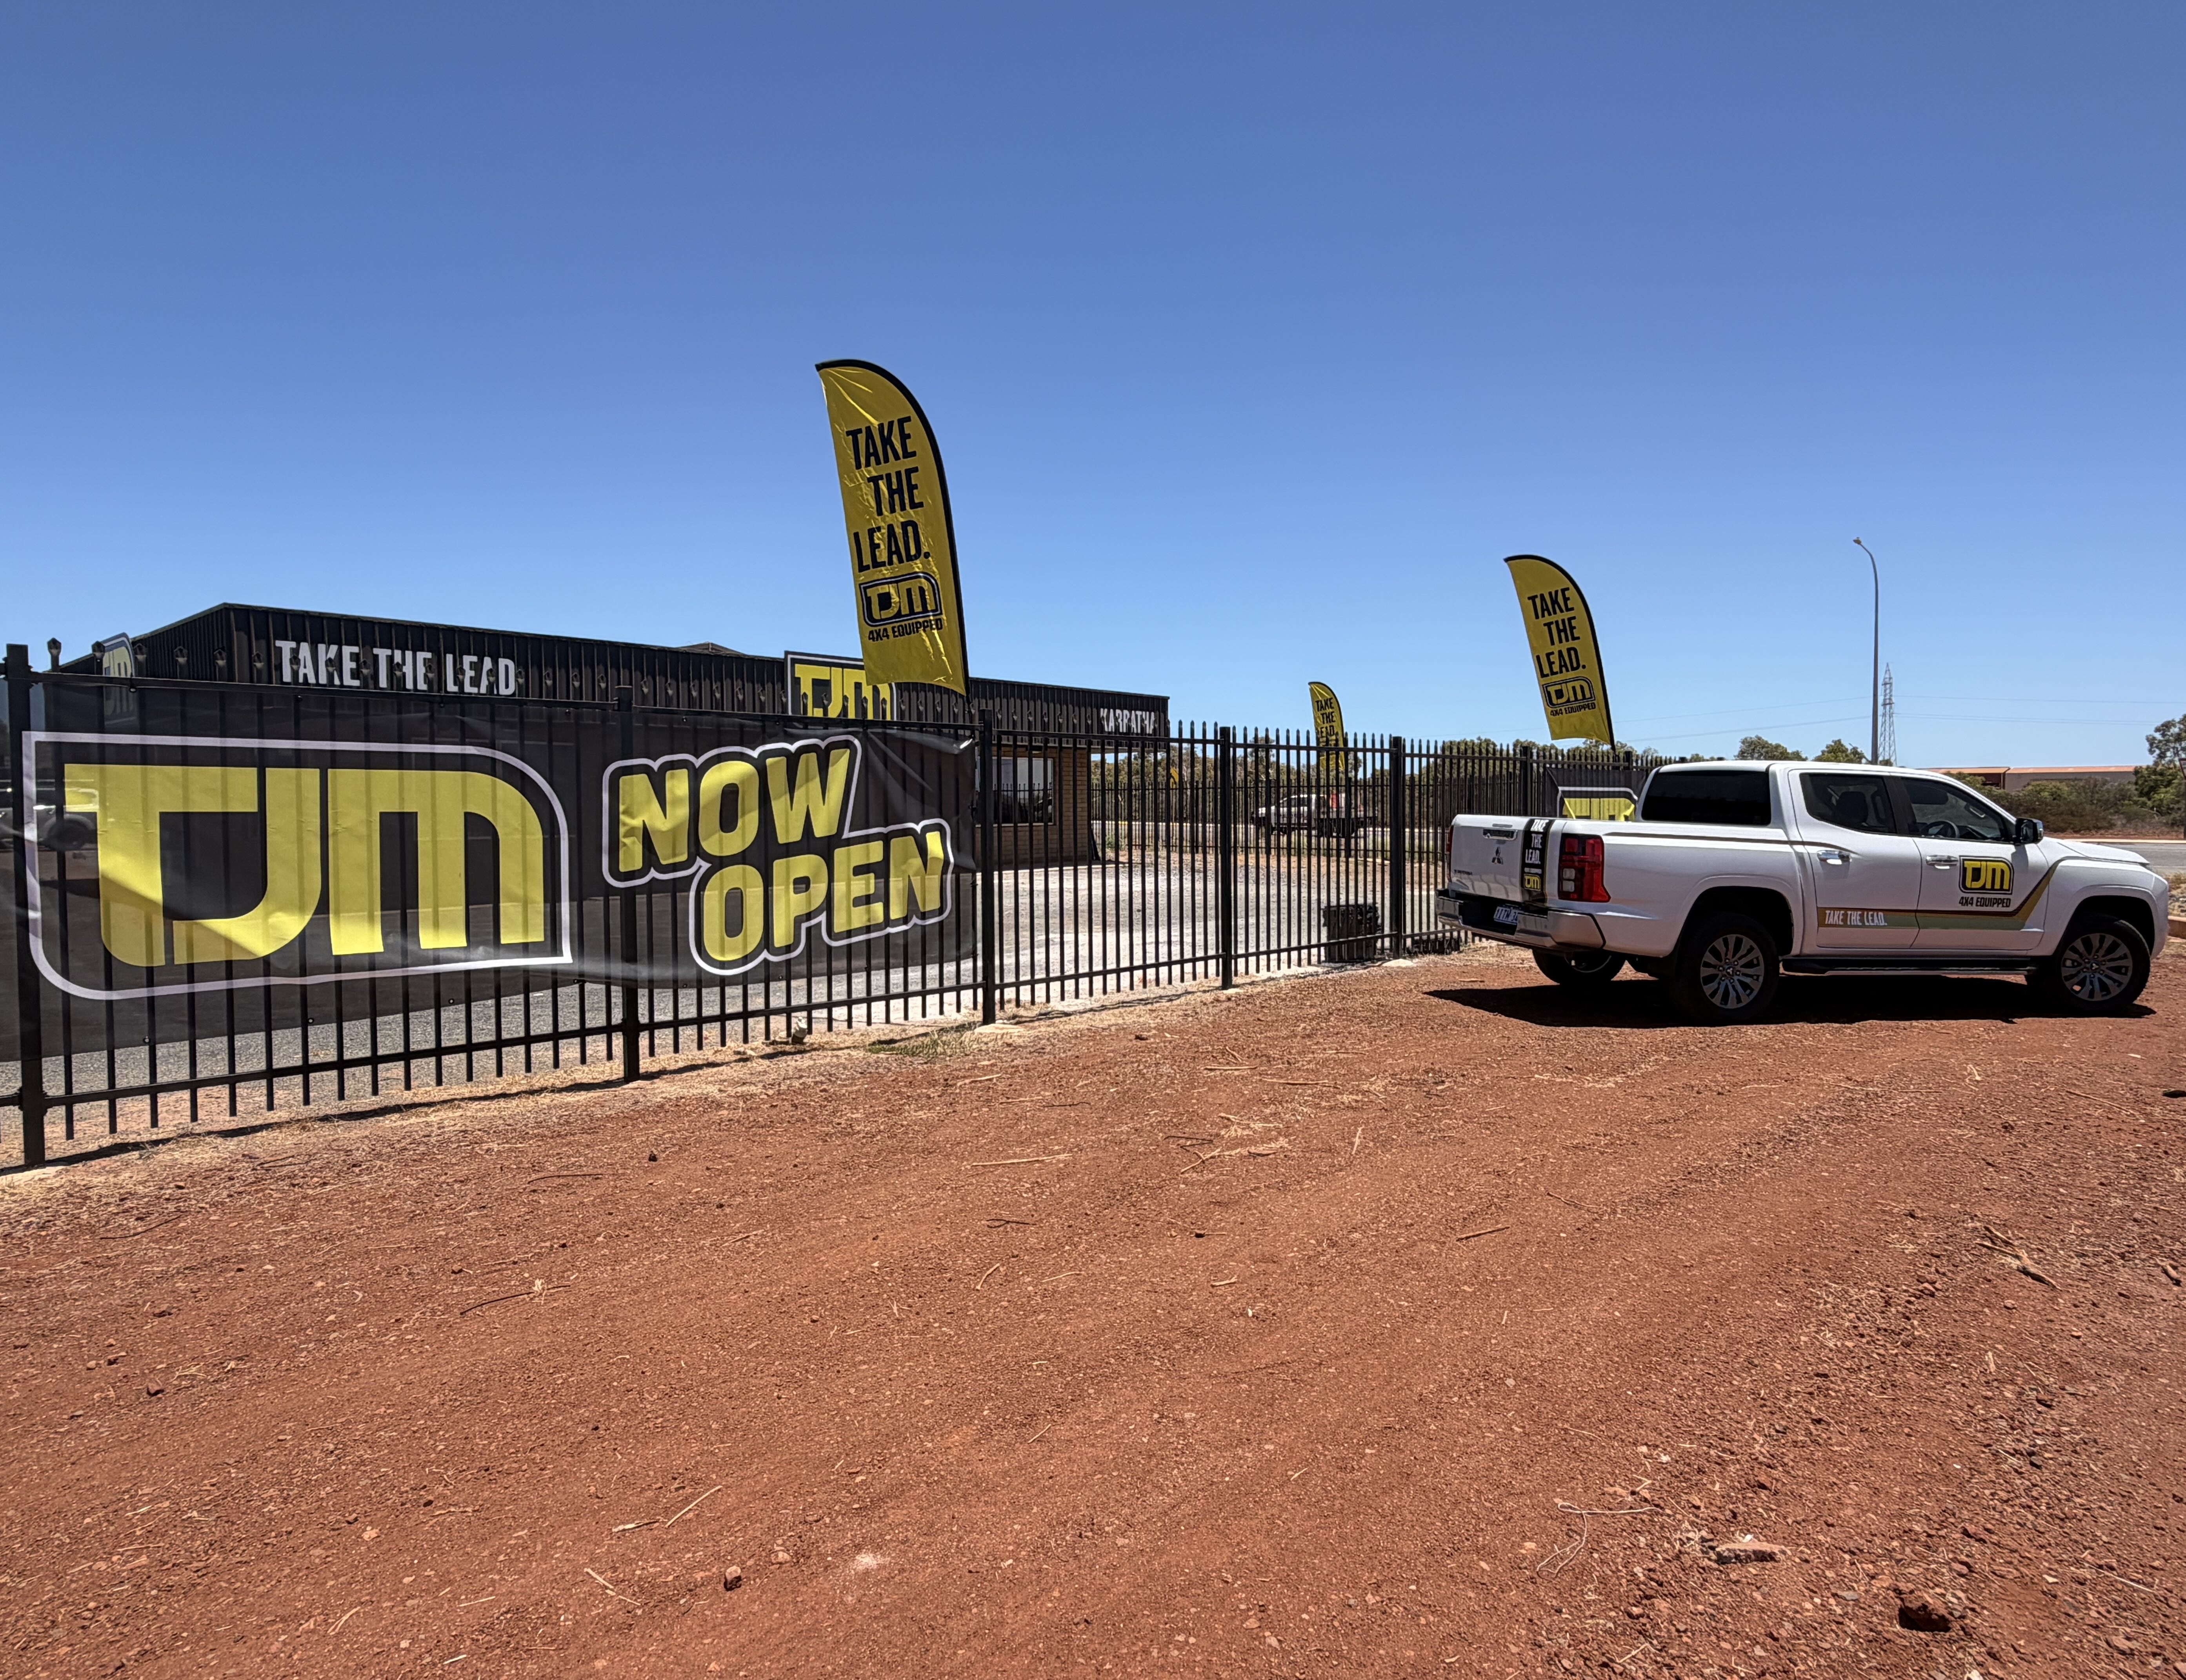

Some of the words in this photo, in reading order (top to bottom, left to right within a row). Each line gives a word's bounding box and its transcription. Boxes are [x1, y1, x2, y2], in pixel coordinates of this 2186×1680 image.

[846, 416, 917, 470] TAKE
[867, 466, 924, 517] THE
[853, 520, 930, 573] LEAD.
[1527, 587, 1575, 620] TAKE
[868, 627, 889, 642] 4X4
[892, 618, 943, 638] EQUIPPED
[1543, 616, 1580, 646] THE
[275, 640, 360, 686] TAKE
[373, 647, 432, 690] THE
[446, 653, 516, 696] LEAD
[1536, 647, 1586, 678] LEAD.
[1315, 697, 1335, 712] TAKE
[1320, 711, 1336, 724] THE
[1564, 702, 1596, 714] EQUIPPED
[619, 748, 850, 873] NOW
[1531, 834, 1543, 848] THE
[704, 831, 944, 961] OPEN
[1959, 896, 1974, 907] 4X4
[1975, 897, 2011, 907] EQUIPPED
[1825, 910, 1845, 925] TAKE
[1847, 911, 1862, 925] THE
[1864, 911, 1888, 926] LEAD.
